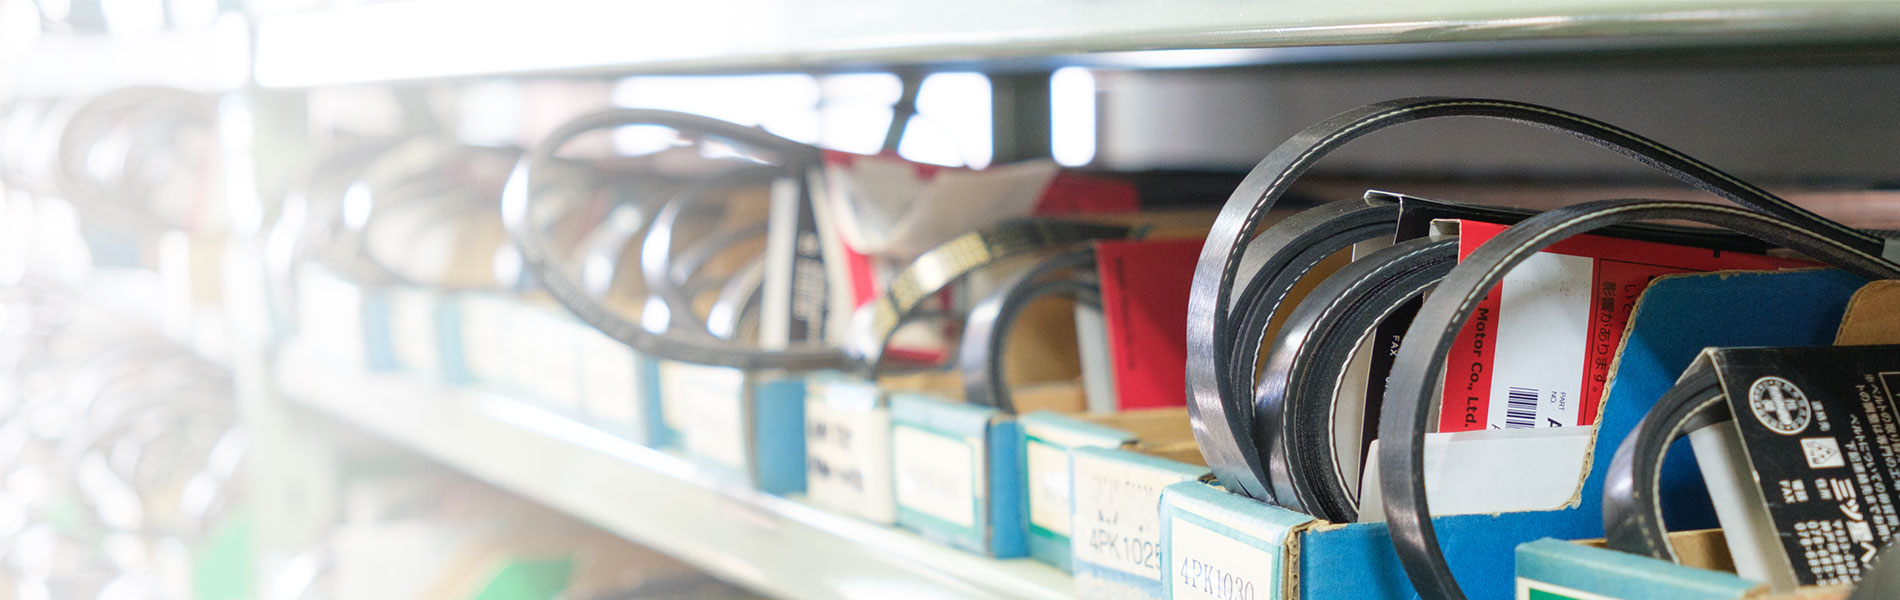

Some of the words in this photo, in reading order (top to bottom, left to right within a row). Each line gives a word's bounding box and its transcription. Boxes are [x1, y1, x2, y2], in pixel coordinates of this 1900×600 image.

[1389, 335, 1401, 356] FAX
[1473, 307, 1489, 357] Motor
[1467, 362, 1483, 390] Co.,
[1464, 397, 1479, 428] Ltd.
[1558, 391, 1567, 412] PART
[1778, 479, 1796, 504] FAX
[1180, 556, 1255, 600] 4PK1030
